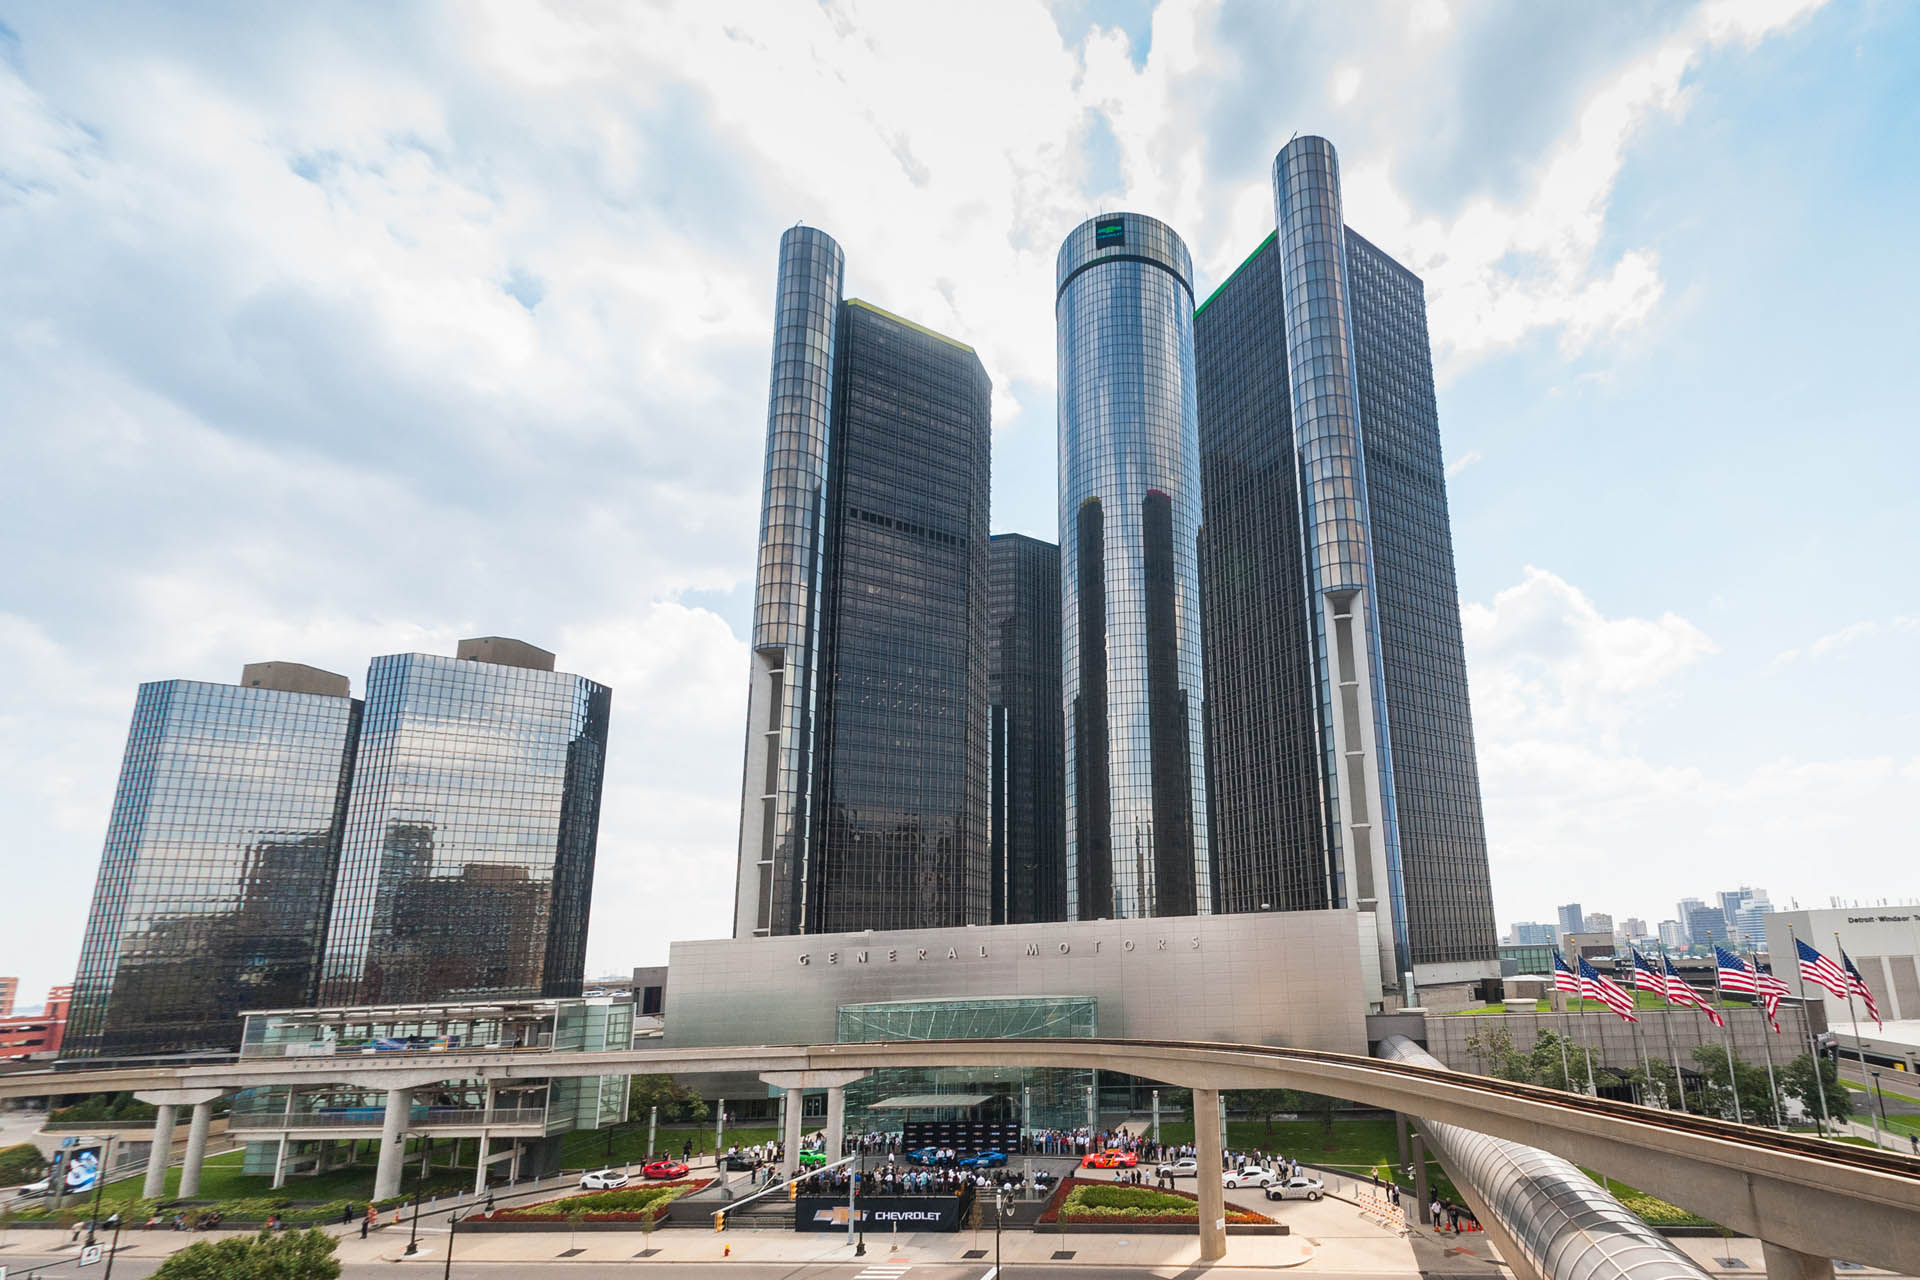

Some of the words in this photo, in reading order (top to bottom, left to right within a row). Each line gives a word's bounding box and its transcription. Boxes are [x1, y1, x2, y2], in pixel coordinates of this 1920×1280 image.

[798, 944, 989, 966] GENERAL
[1025, 936, 1201, 957] MOTORS
[874, 1211, 942, 1221] CHEVROLET
